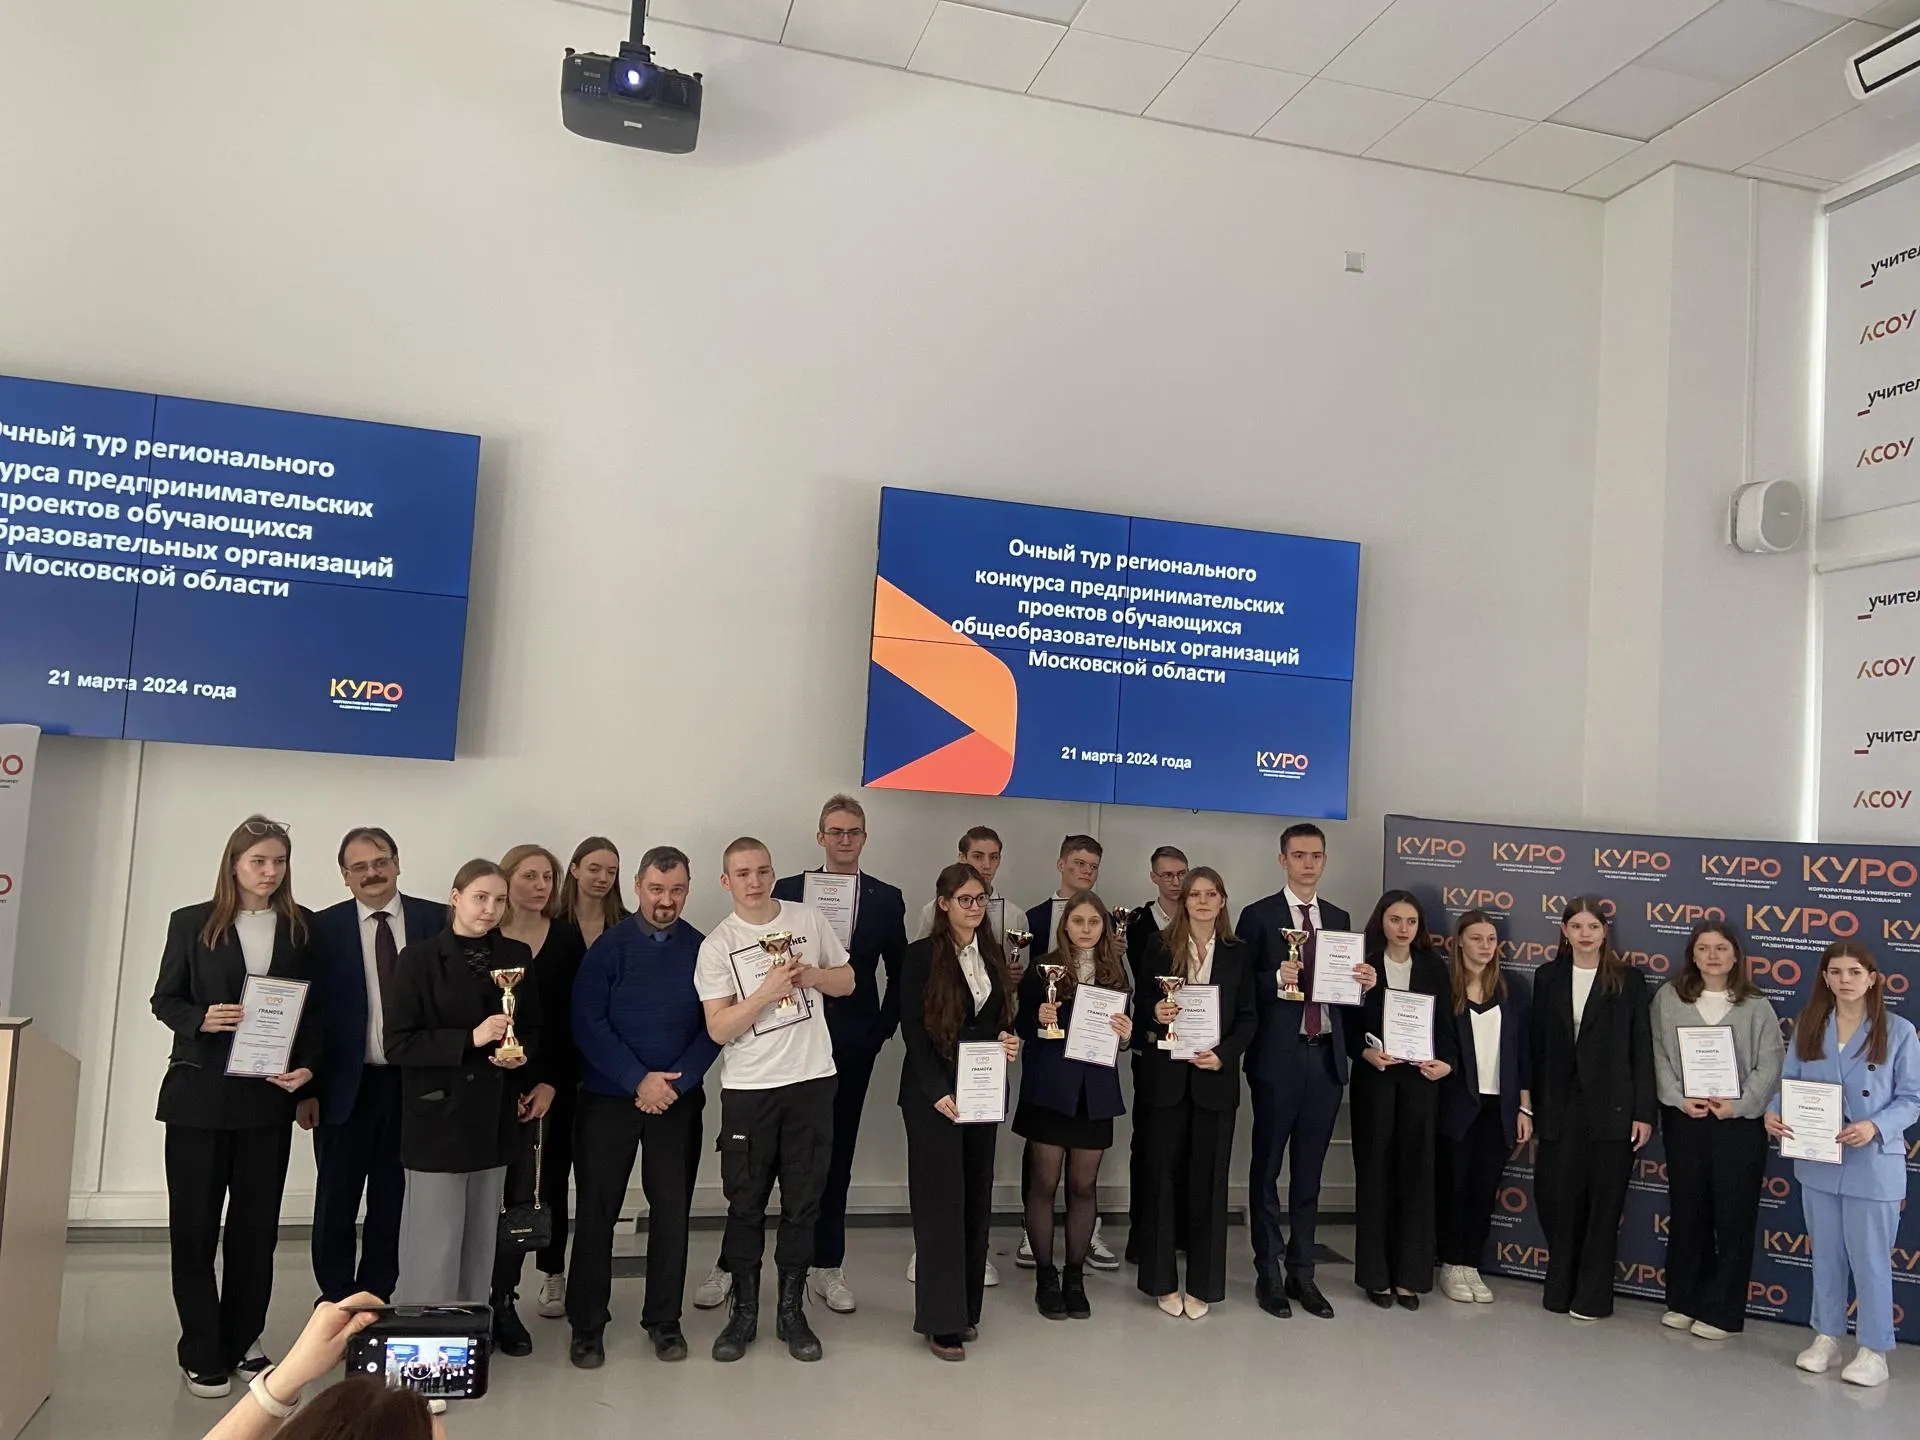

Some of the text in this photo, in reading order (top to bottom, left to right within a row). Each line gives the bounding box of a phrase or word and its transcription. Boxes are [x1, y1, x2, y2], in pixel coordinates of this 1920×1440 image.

[1871, 246, 1920, 278] учите
[0, 421, 335, 478] чный тур регионального
[67, 469, 374, 518] предпринимательских
[127, 502, 313, 541] обучающихся
[224, 546, 394, 579] организаций
[1009, 538, 1257, 582] Очный тур регионального
[4, 550, 290, 598] Московской области
[975, 570, 1285, 615] конкурса предпринимательских
[1018, 600, 1242, 635] проектов обучающихся
[950, 616, 1300, 667] общеобразовательных организаций
[1028, 650, 1226, 684] Московской области
[47, 669, 237, 700] 21 марта 2024 года
[330, 678, 403, 701] КУРО
[1061, 746, 1192, 770] 21 марта 2024 года
[1256, 751, 1309, 770] КУРО
[1396, 836, 1466, 857] КУРО
[1492, 841, 1566, 864] КУРО
[1593, 847, 1671, 871] КУРО
[1701, 854, 1781, 878] КУРО
[1803, 855, 1918, 887] КУРО
[1442, 886, 1514, 910] КУРО
[1808, 886, 1912, 898] КОРПОРАТИВНЫЙ УНИВЕРСИТЕТ
[1818, 893, 1901, 903] РАЗВИТИЯ ОБРАЗОВАНИЯ
[1746, 903, 1859, 937] КУРО
[1883, 919, 1920, 941] КУ
[1751, 935, 1807, 944] КОРПОРАТИВНЫЙ
[1794, 944, 1825, 952] ОБРАЗОВ
[1612, 950, 1670, 973] УРО
[1746, 956, 1802, 986] РО
[1497, 1242, 1550, 1266] КУР
[1746, 1281, 1789, 1306] РО
